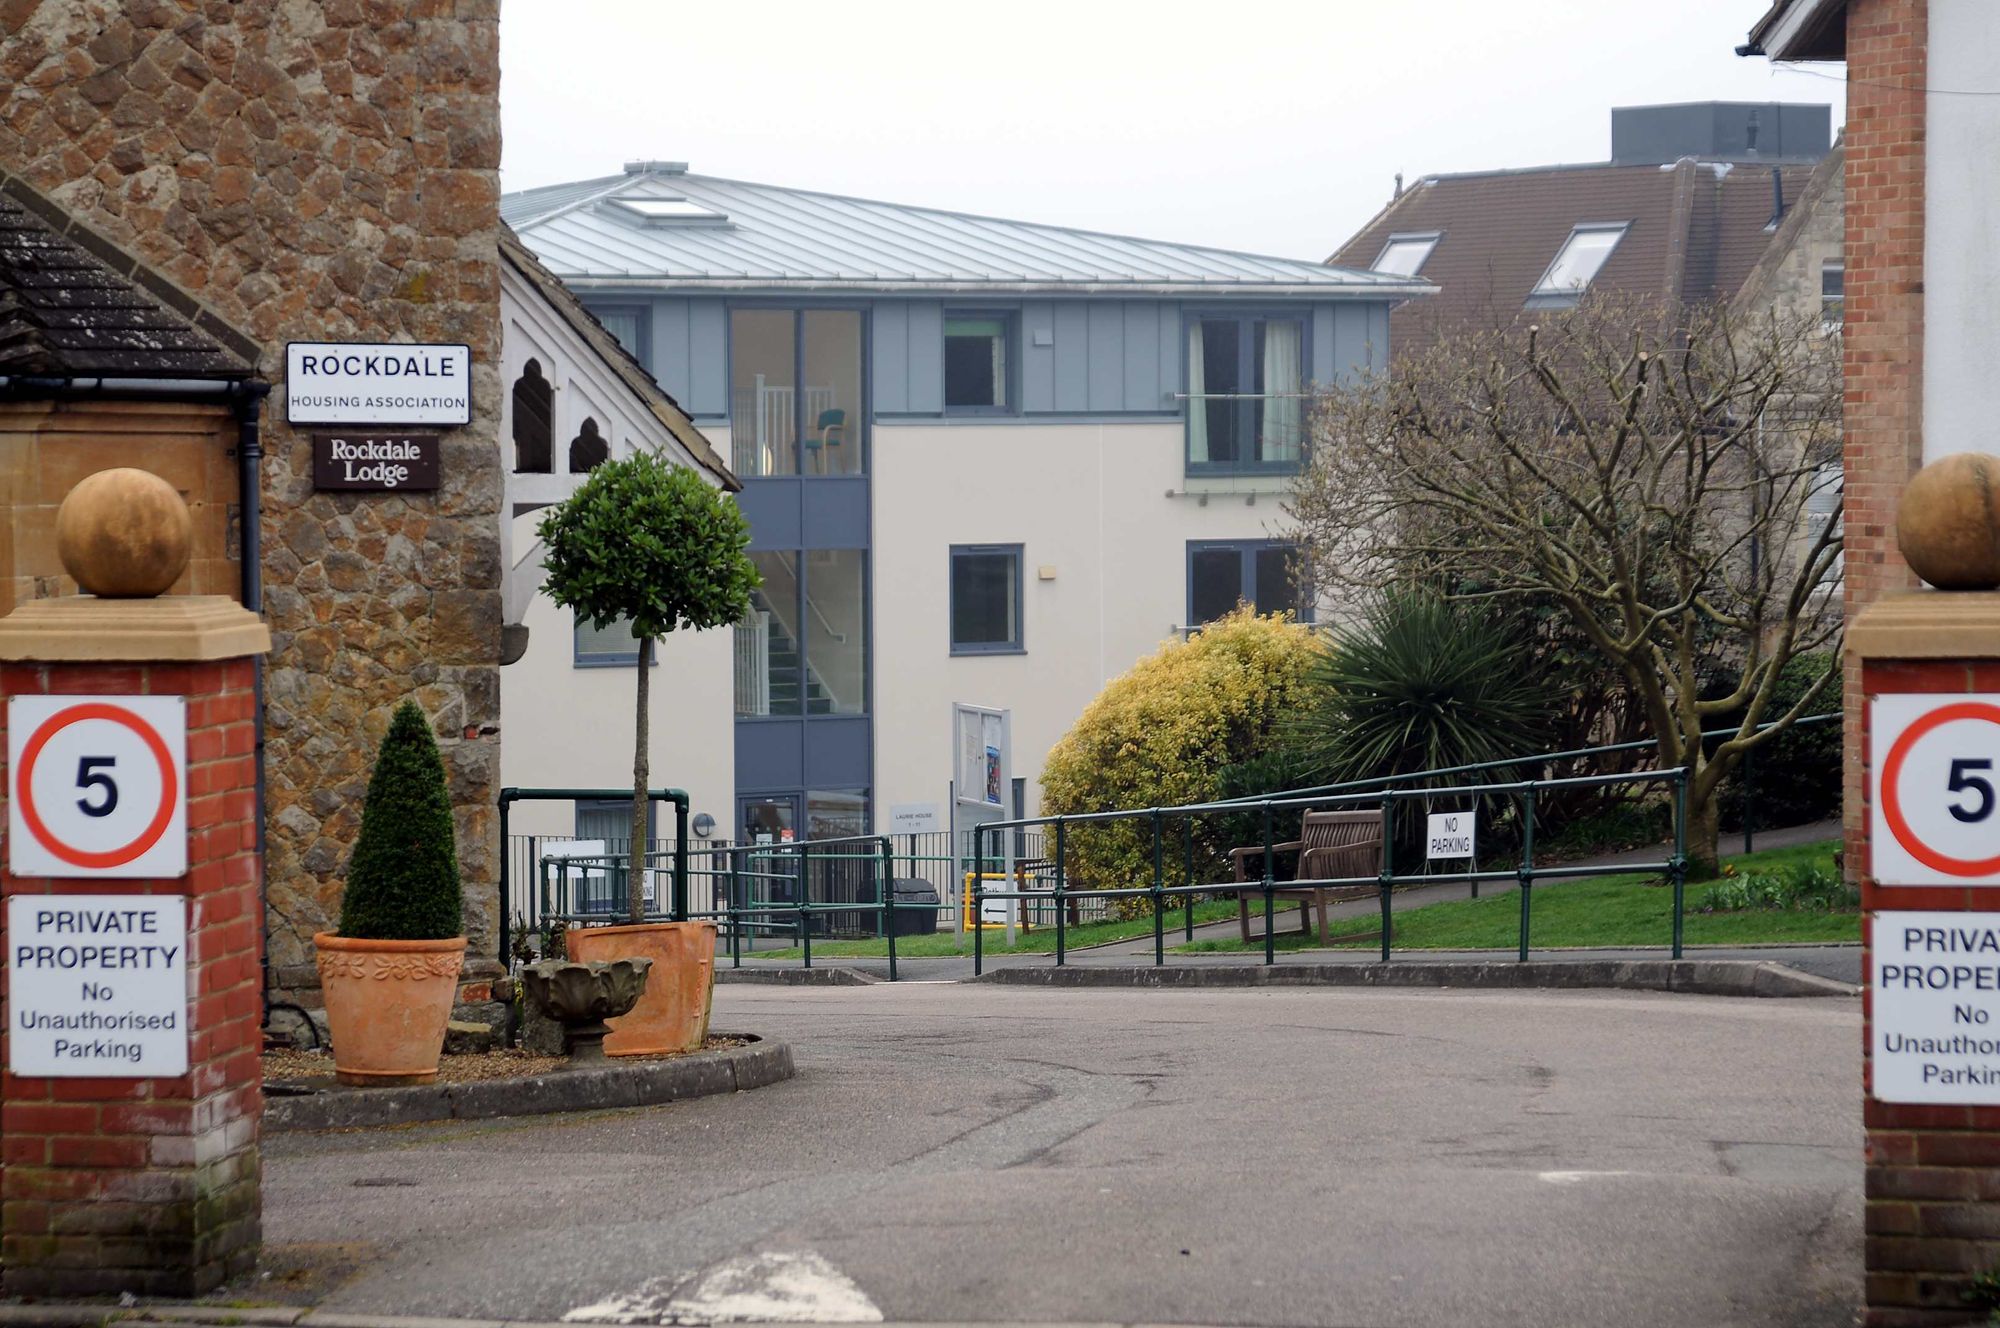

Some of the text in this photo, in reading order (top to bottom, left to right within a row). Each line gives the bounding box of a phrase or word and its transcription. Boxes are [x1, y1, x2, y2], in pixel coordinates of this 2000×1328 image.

[301, 355, 455, 377] ROCKDALE
[291, 396, 465, 409] HOUSING ASSOCIATION
[331, 439, 421, 460] Rockdale
[343, 461, 409, 487] Lodge
[76, 756, 119, 817] 5
[1947, 758, 1996, 823] 5
[1444, 817, 1458, 833] NO
[1431, 837, 1470, 854] PARKING
[37, 910, 157, 934] PRIVATE
[1904, 927, 2000, 953] PRIVA
[17, 945, 178, 969] PROPERTY
[1882, 964, 2000, 991] PROPE
[82, 982, 113, 1001] No
[20, 1010, 176, 1030] Unauthorised
[1954, 1004, 1990, 1025] No
[54, 1039, 142, 1063] Parking
